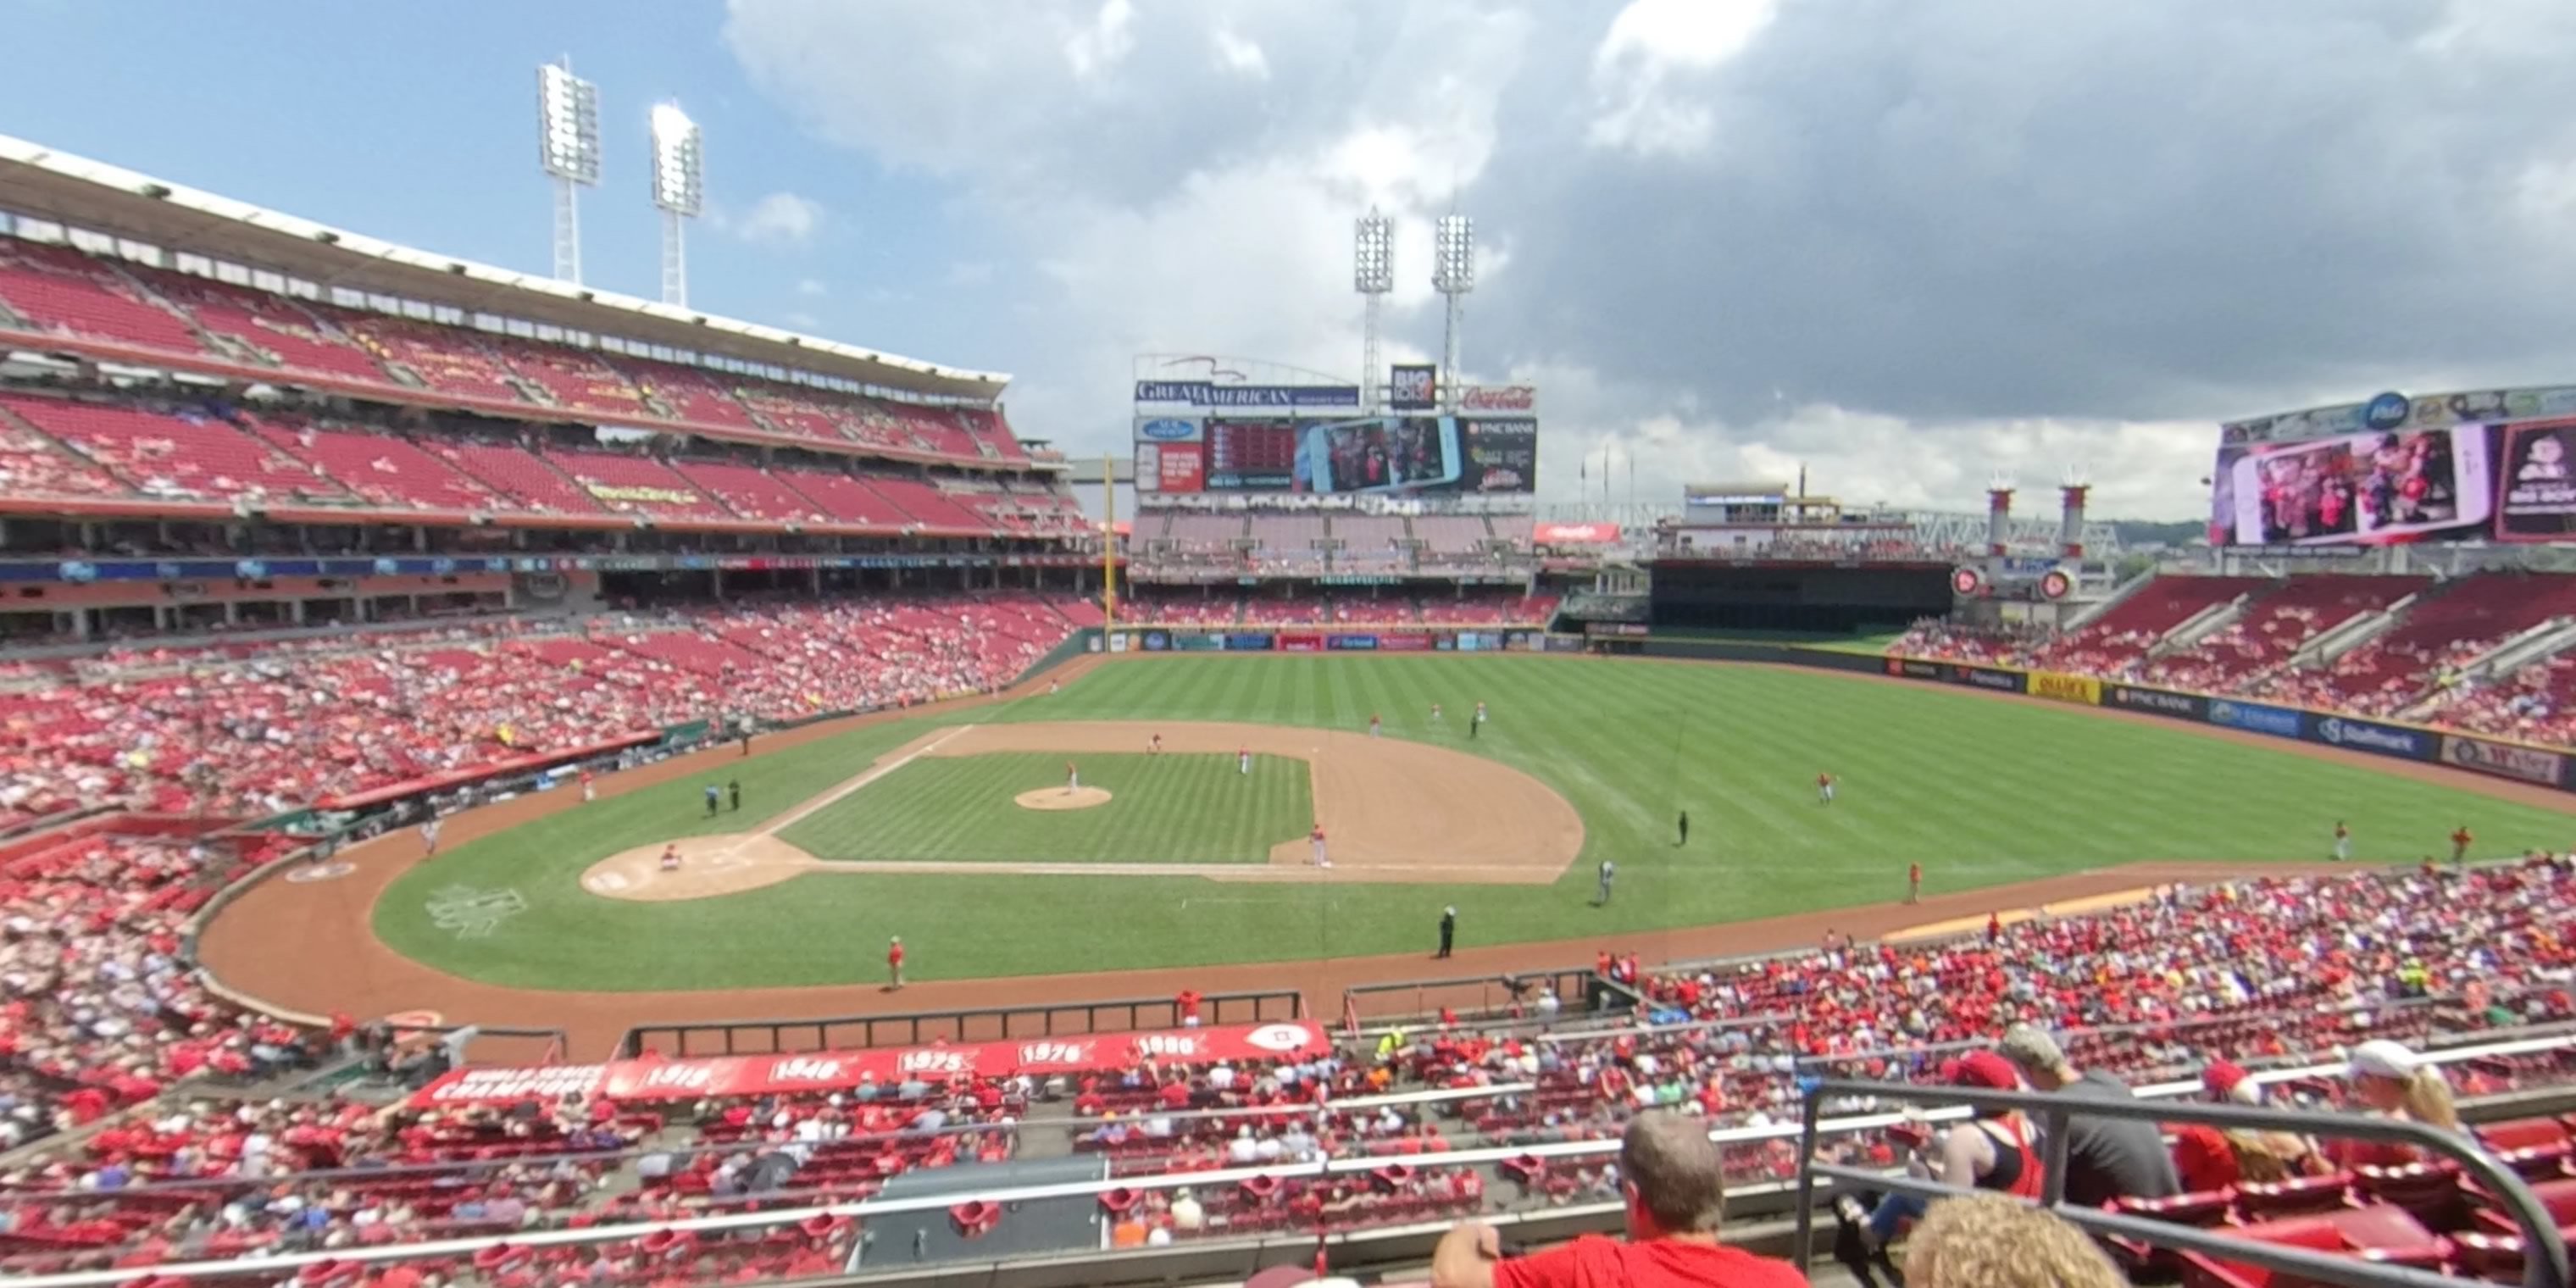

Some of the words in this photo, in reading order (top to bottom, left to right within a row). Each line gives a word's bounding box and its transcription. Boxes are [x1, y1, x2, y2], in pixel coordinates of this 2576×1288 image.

[1394, 370, 1430, 387] BIG
[1138, 382, 1199, 399] GREAT
[1195, 387, 1291, 405] AMERICAN
[1505, 423, 1535, 434] BANK
[2129, 691, 2157, 708] PNC
[2158, 695, 2193, 713] BANK
[903, 1052, 961, 1070] 1975
[646, 1064, 711, 1086] 1919
